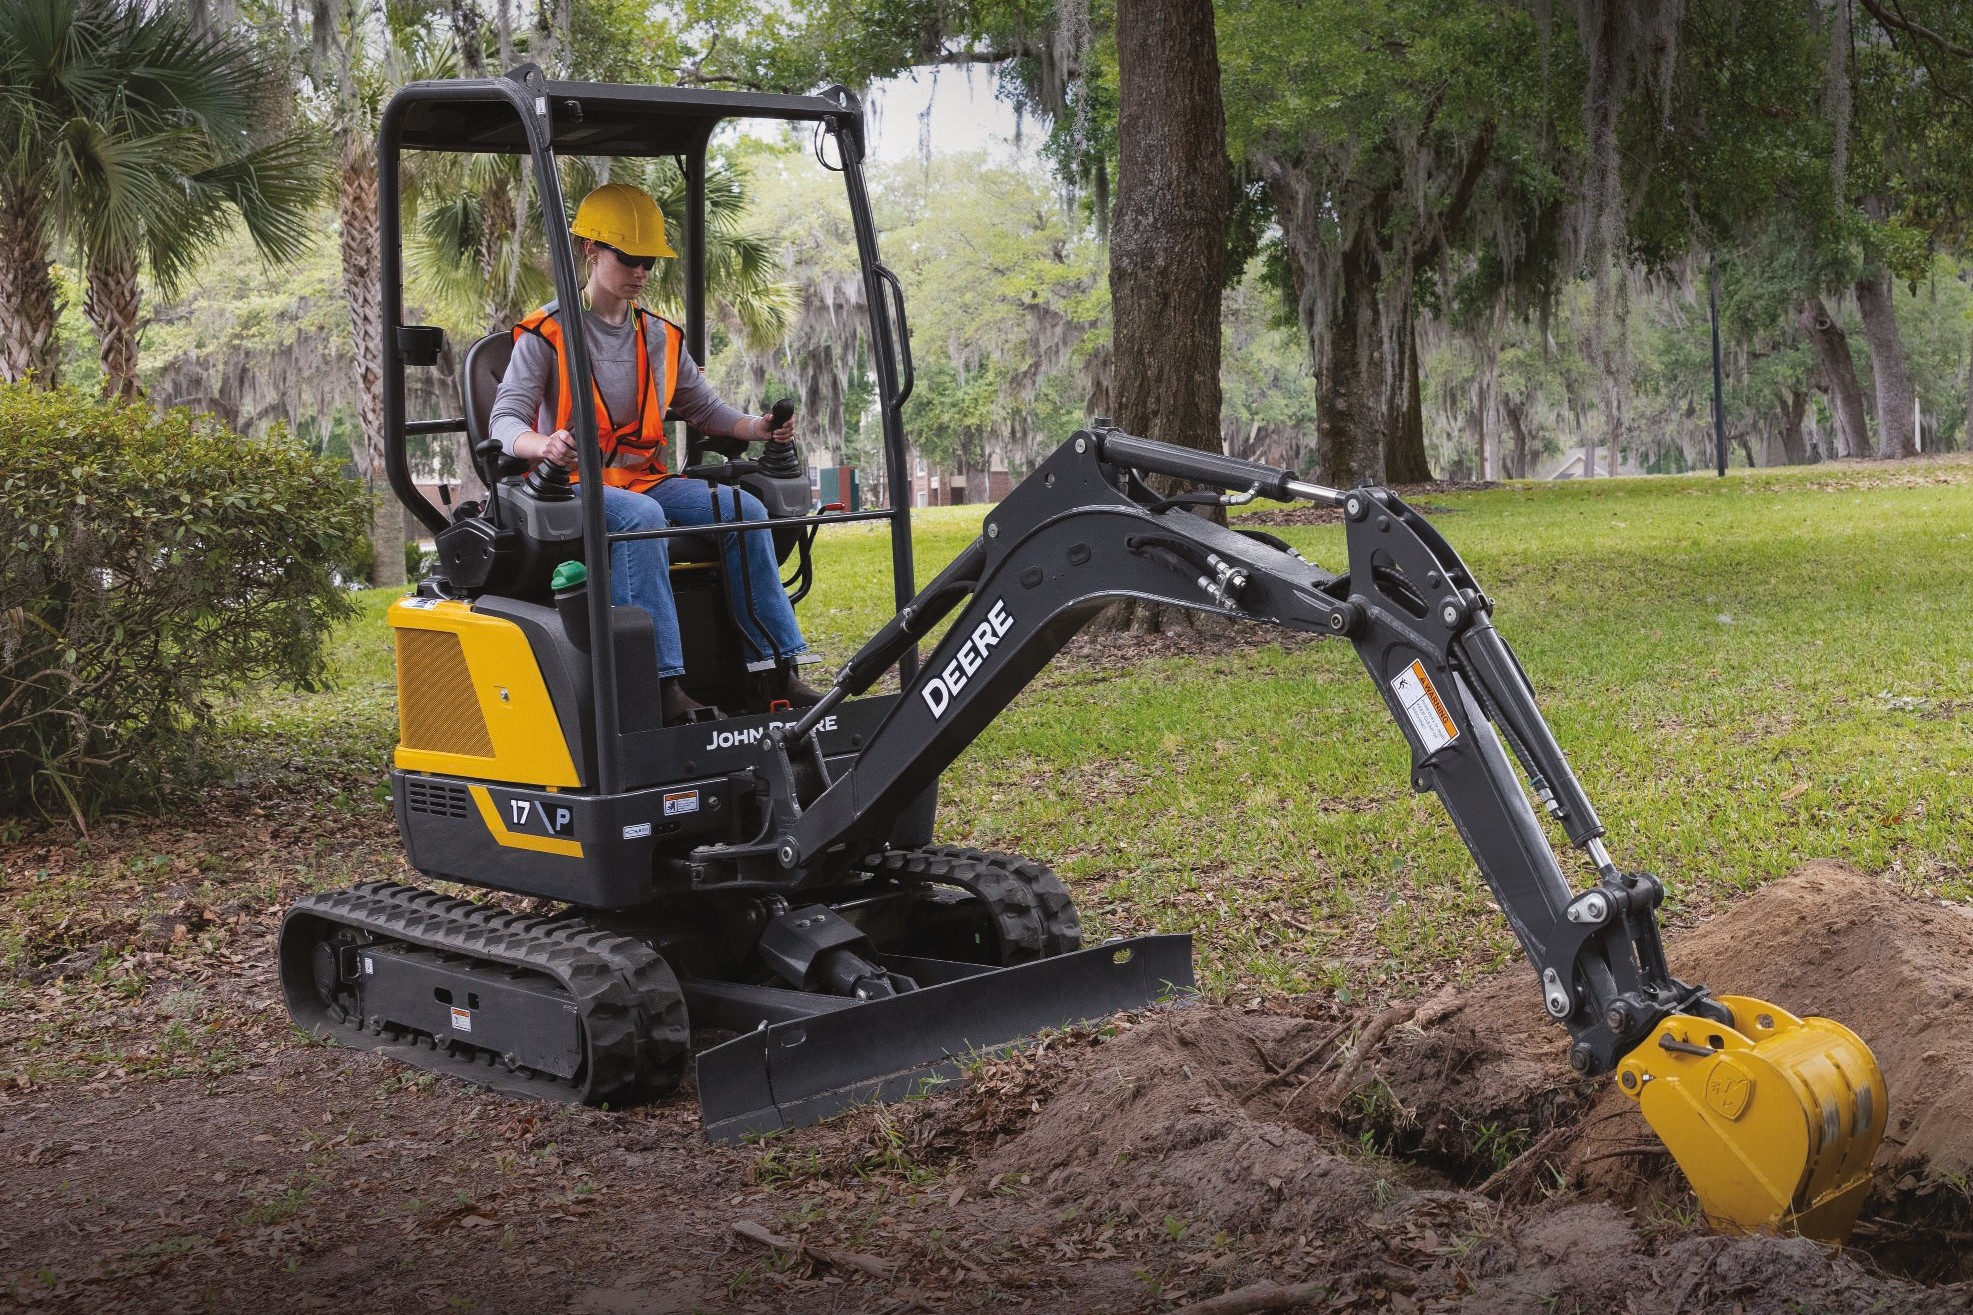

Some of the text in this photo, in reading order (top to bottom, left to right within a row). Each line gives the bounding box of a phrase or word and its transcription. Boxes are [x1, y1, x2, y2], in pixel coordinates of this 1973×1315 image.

[921, 598, 1015, 719] DEERE
[1425, 684, 1449, 724] WARNING
[706, 727, 763, 751] JOHN
[510, 800, 571, 831] 17 P
